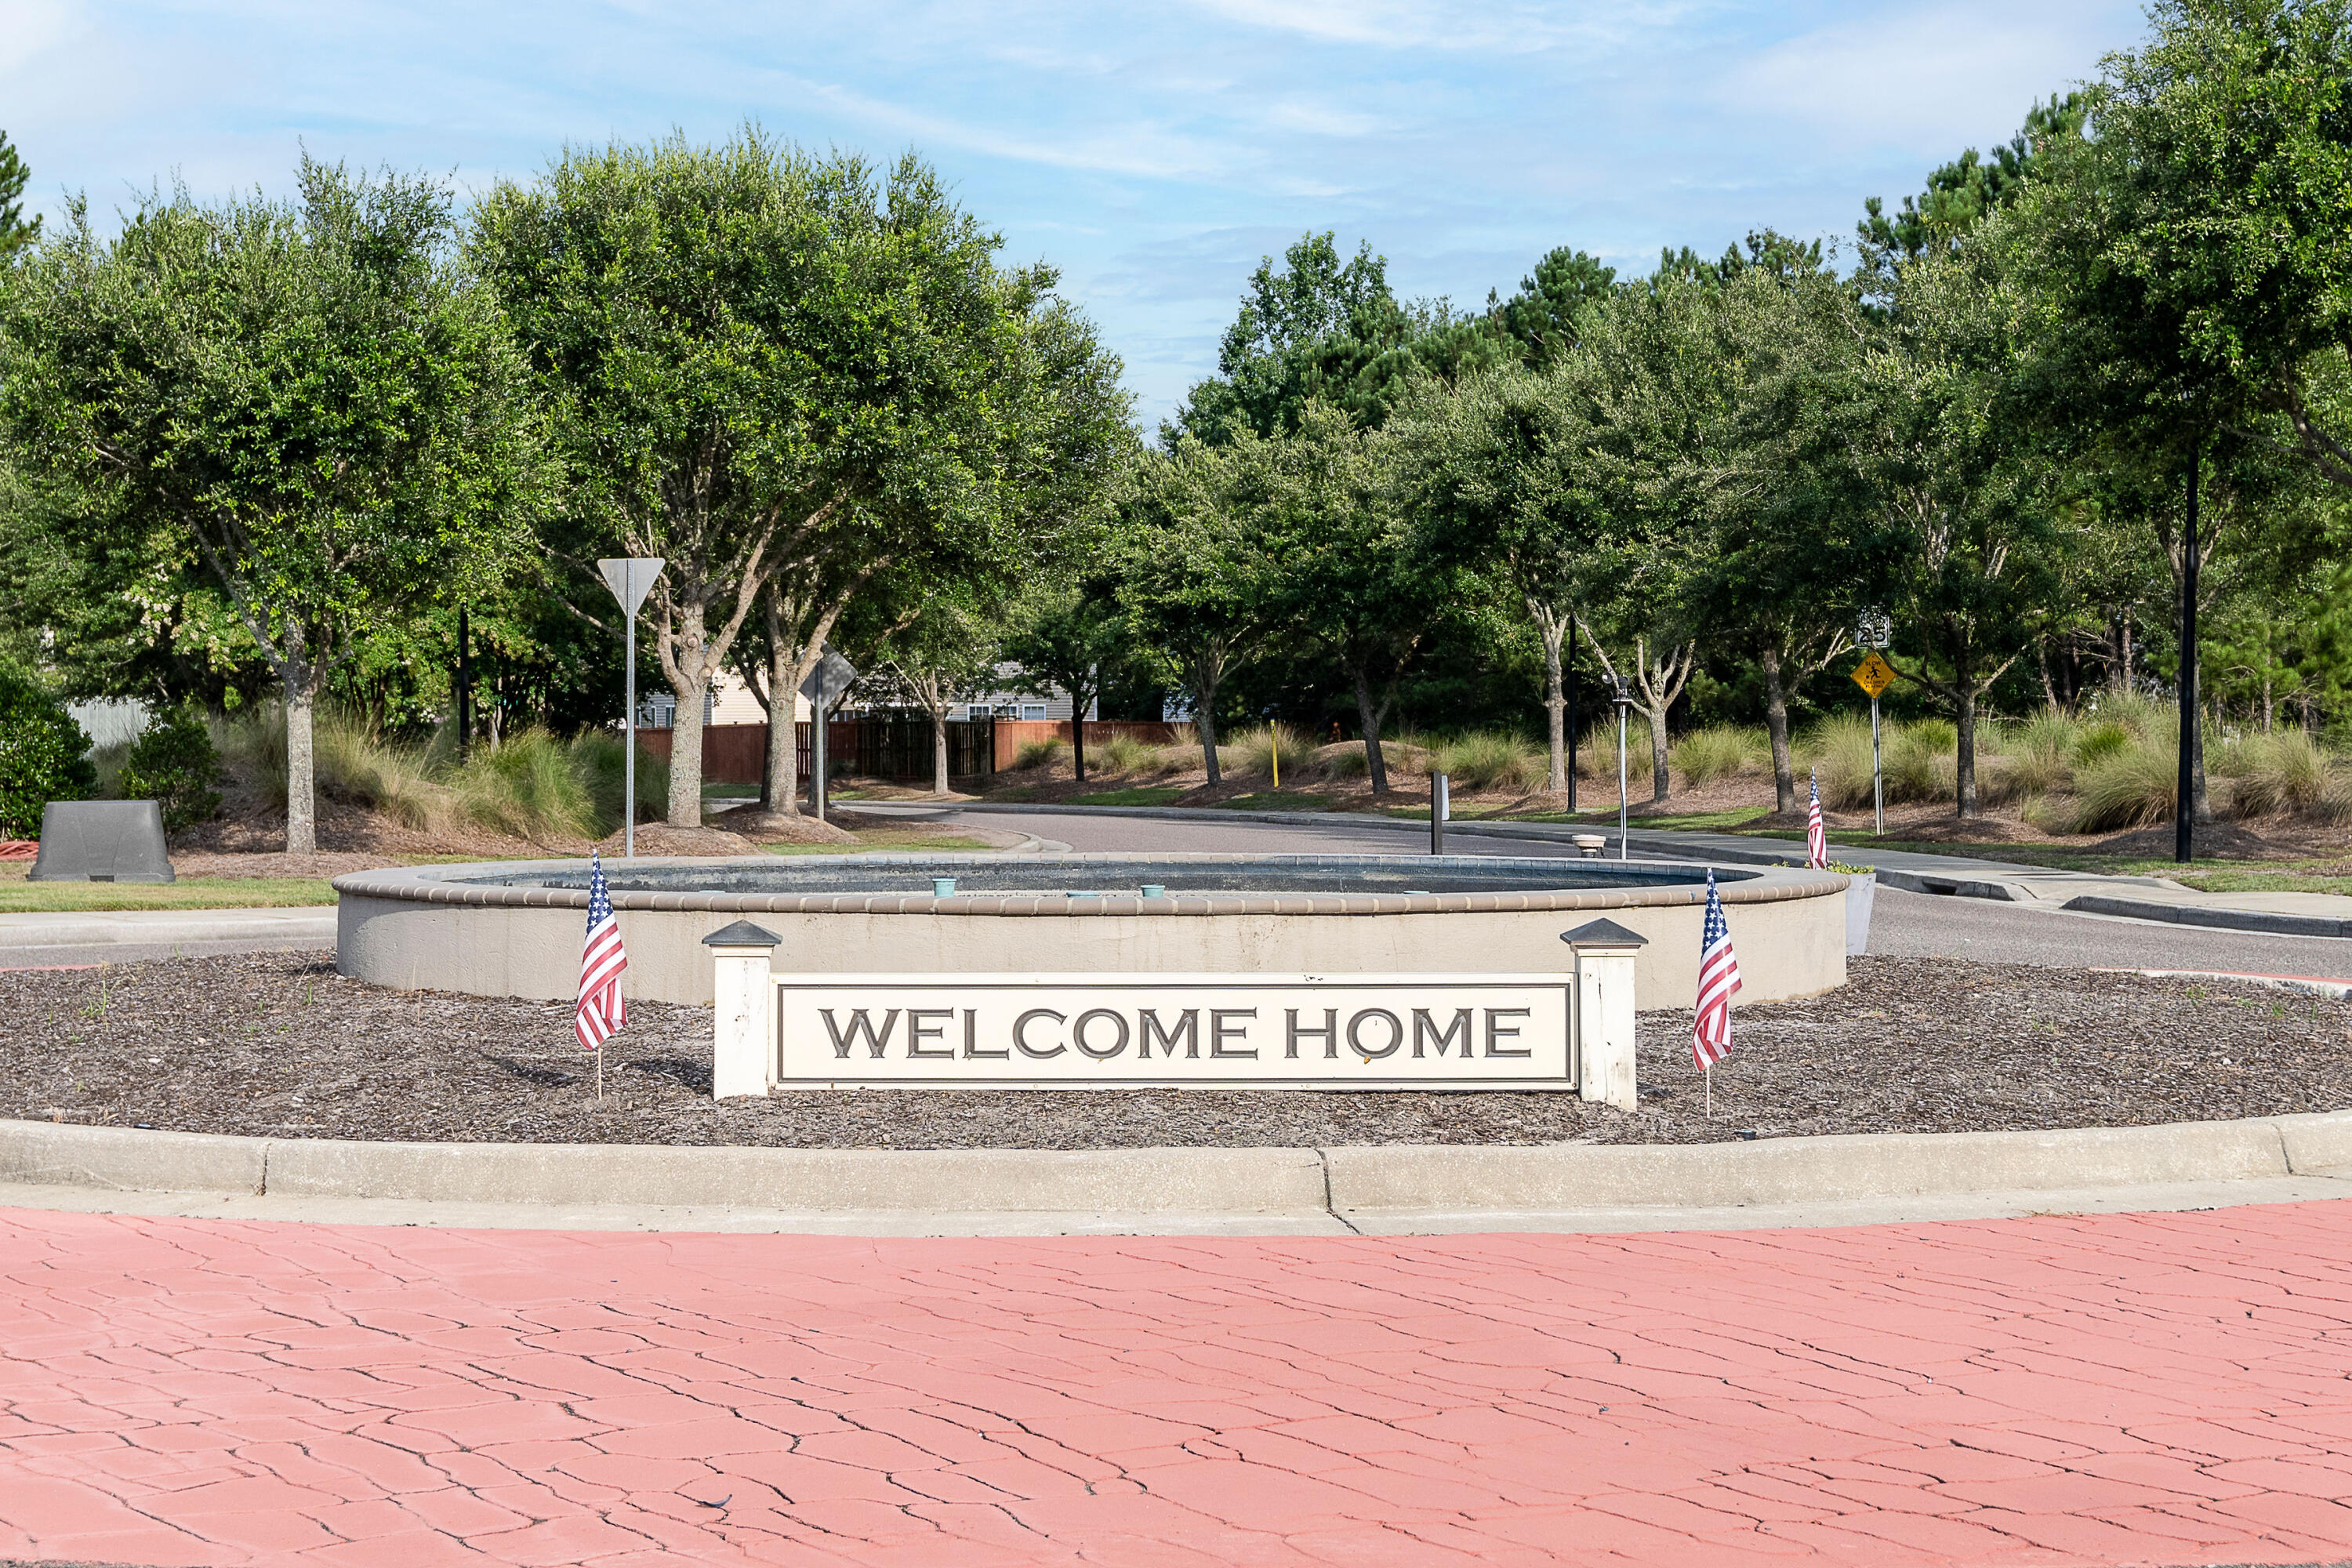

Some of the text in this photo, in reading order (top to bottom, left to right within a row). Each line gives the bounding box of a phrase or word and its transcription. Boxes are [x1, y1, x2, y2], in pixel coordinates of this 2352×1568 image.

[1860, 626, 1886, 642] 25
[818, 1007, 1531, 1059] WELCOME HOME
